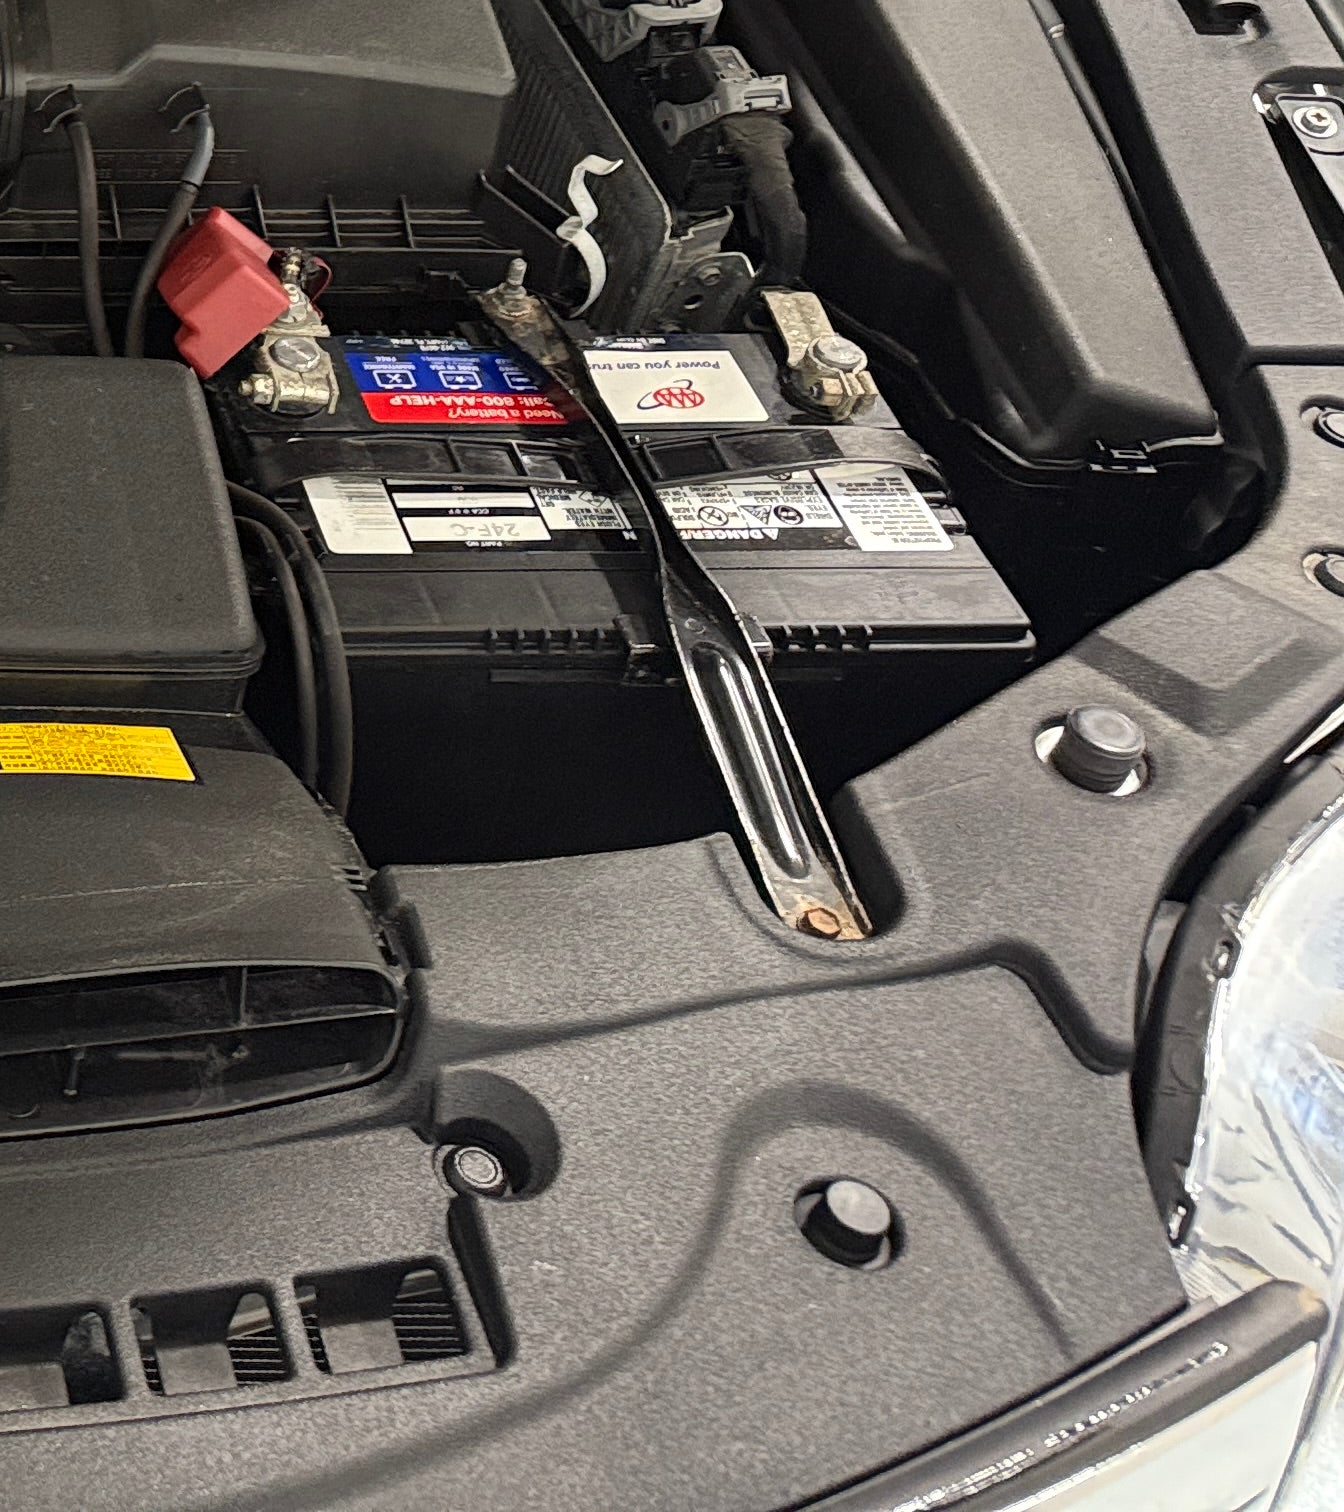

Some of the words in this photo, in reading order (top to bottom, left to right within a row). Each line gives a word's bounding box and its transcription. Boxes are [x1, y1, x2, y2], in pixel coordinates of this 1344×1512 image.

[617, 362, 639, 370] can
[645, 360, 673, 370] you
[676, 360, 720, 370] Power
[390, 395, 515, 407] 800-AAA-HELP
[654, 388, 704, 408] AAA
[448, 407, 509, 419] battery?
[511, 410, 522, 418] a
[523, 409, 565, 419] Need
[450, 523, 520, 537] 24F-C
